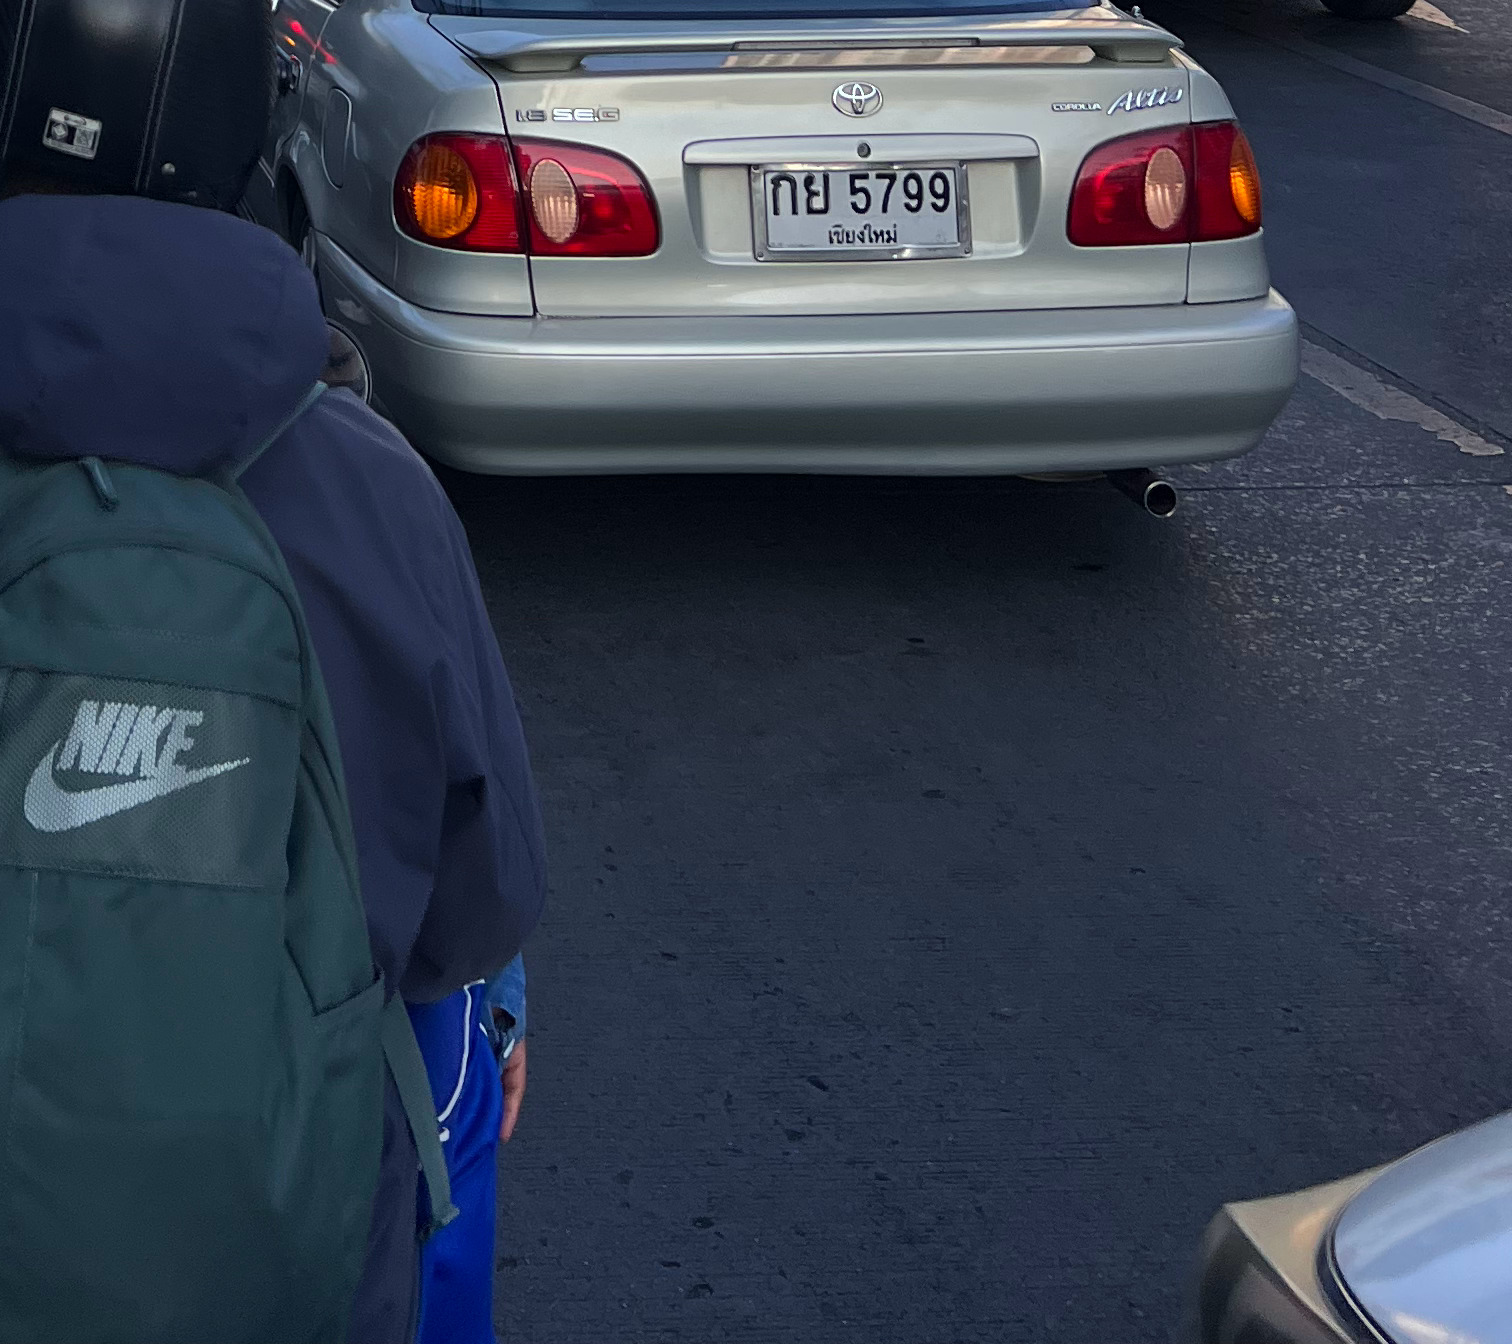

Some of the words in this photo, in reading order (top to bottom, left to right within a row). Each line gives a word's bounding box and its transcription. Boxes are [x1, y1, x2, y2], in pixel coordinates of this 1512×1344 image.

[1051, 102, 1102, 112] COROLLA
[770, 172, 830, 216] กย
[849, 171, 951, 214] 5799
[828, 223, 898, 244] เชียงใหม่
[56, 700, 204, 778] NIKE
